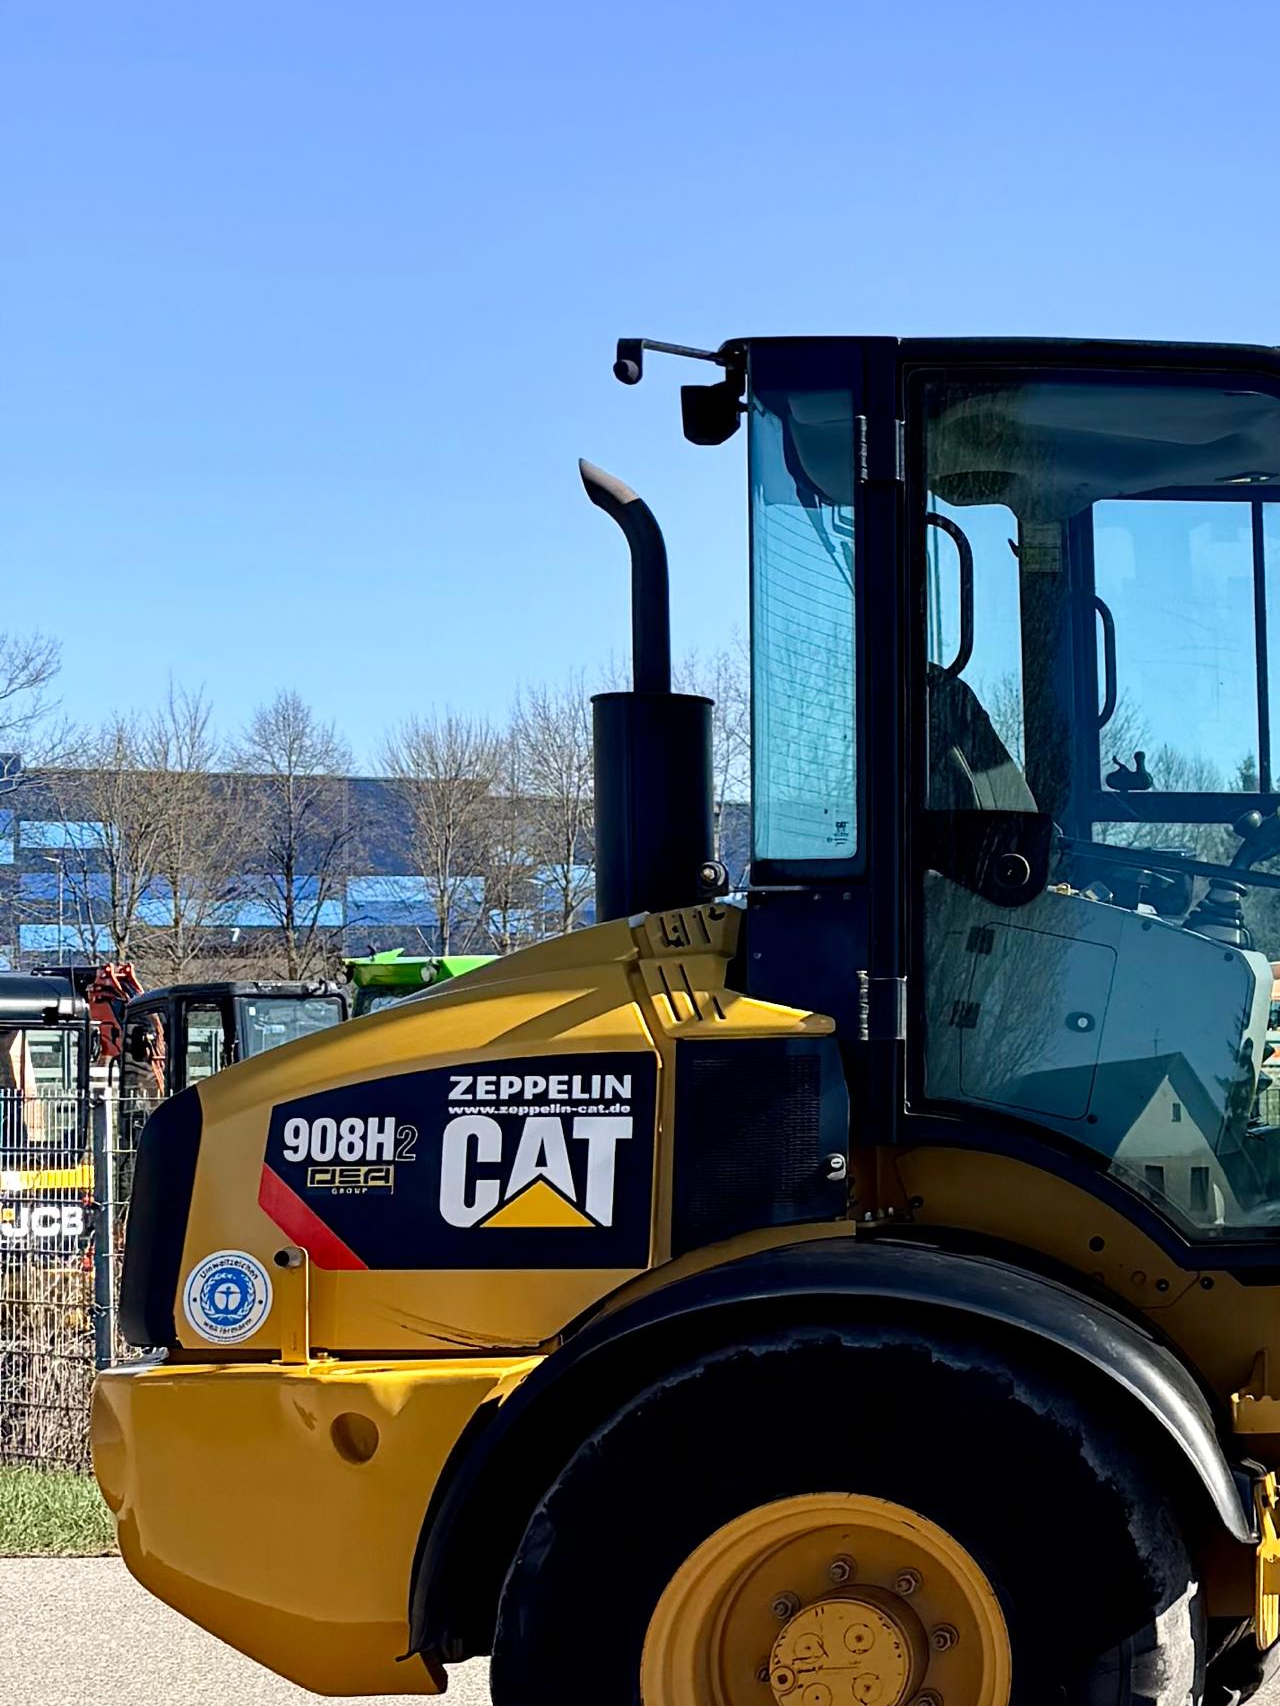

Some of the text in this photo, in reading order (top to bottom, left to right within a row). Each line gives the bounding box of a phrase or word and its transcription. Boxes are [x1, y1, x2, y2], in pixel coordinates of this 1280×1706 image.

[448, 1074, 632, 1100] ZEPPELIN
[448, 1103, 631, 1116] www.zeppelin-cat.de
[439, 1114, 633, 1229] CAT
[331, 1187, 369, 1195] GROUP
[1, 1206, 83, 1238] JCB
